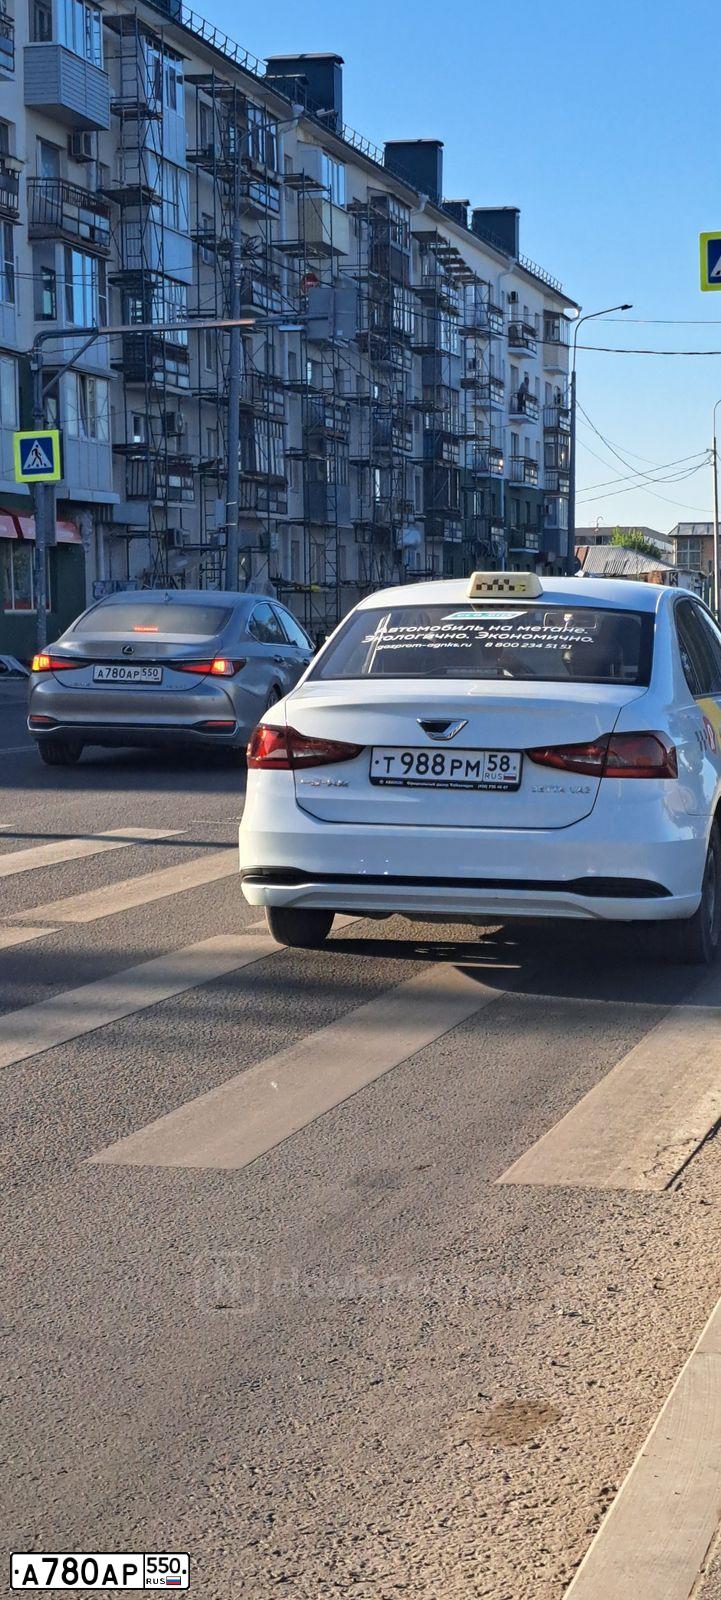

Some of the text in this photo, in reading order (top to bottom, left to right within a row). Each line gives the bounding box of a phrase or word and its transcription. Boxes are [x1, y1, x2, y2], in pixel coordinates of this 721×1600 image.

[375, 624, 484, 635] Автомобиль
[517, 625, 588, 634] метане.
[475, 631, 595, 643] Экономично.
[142, 668, 159, 677] 550
[487, 755, 510, 772] 58
